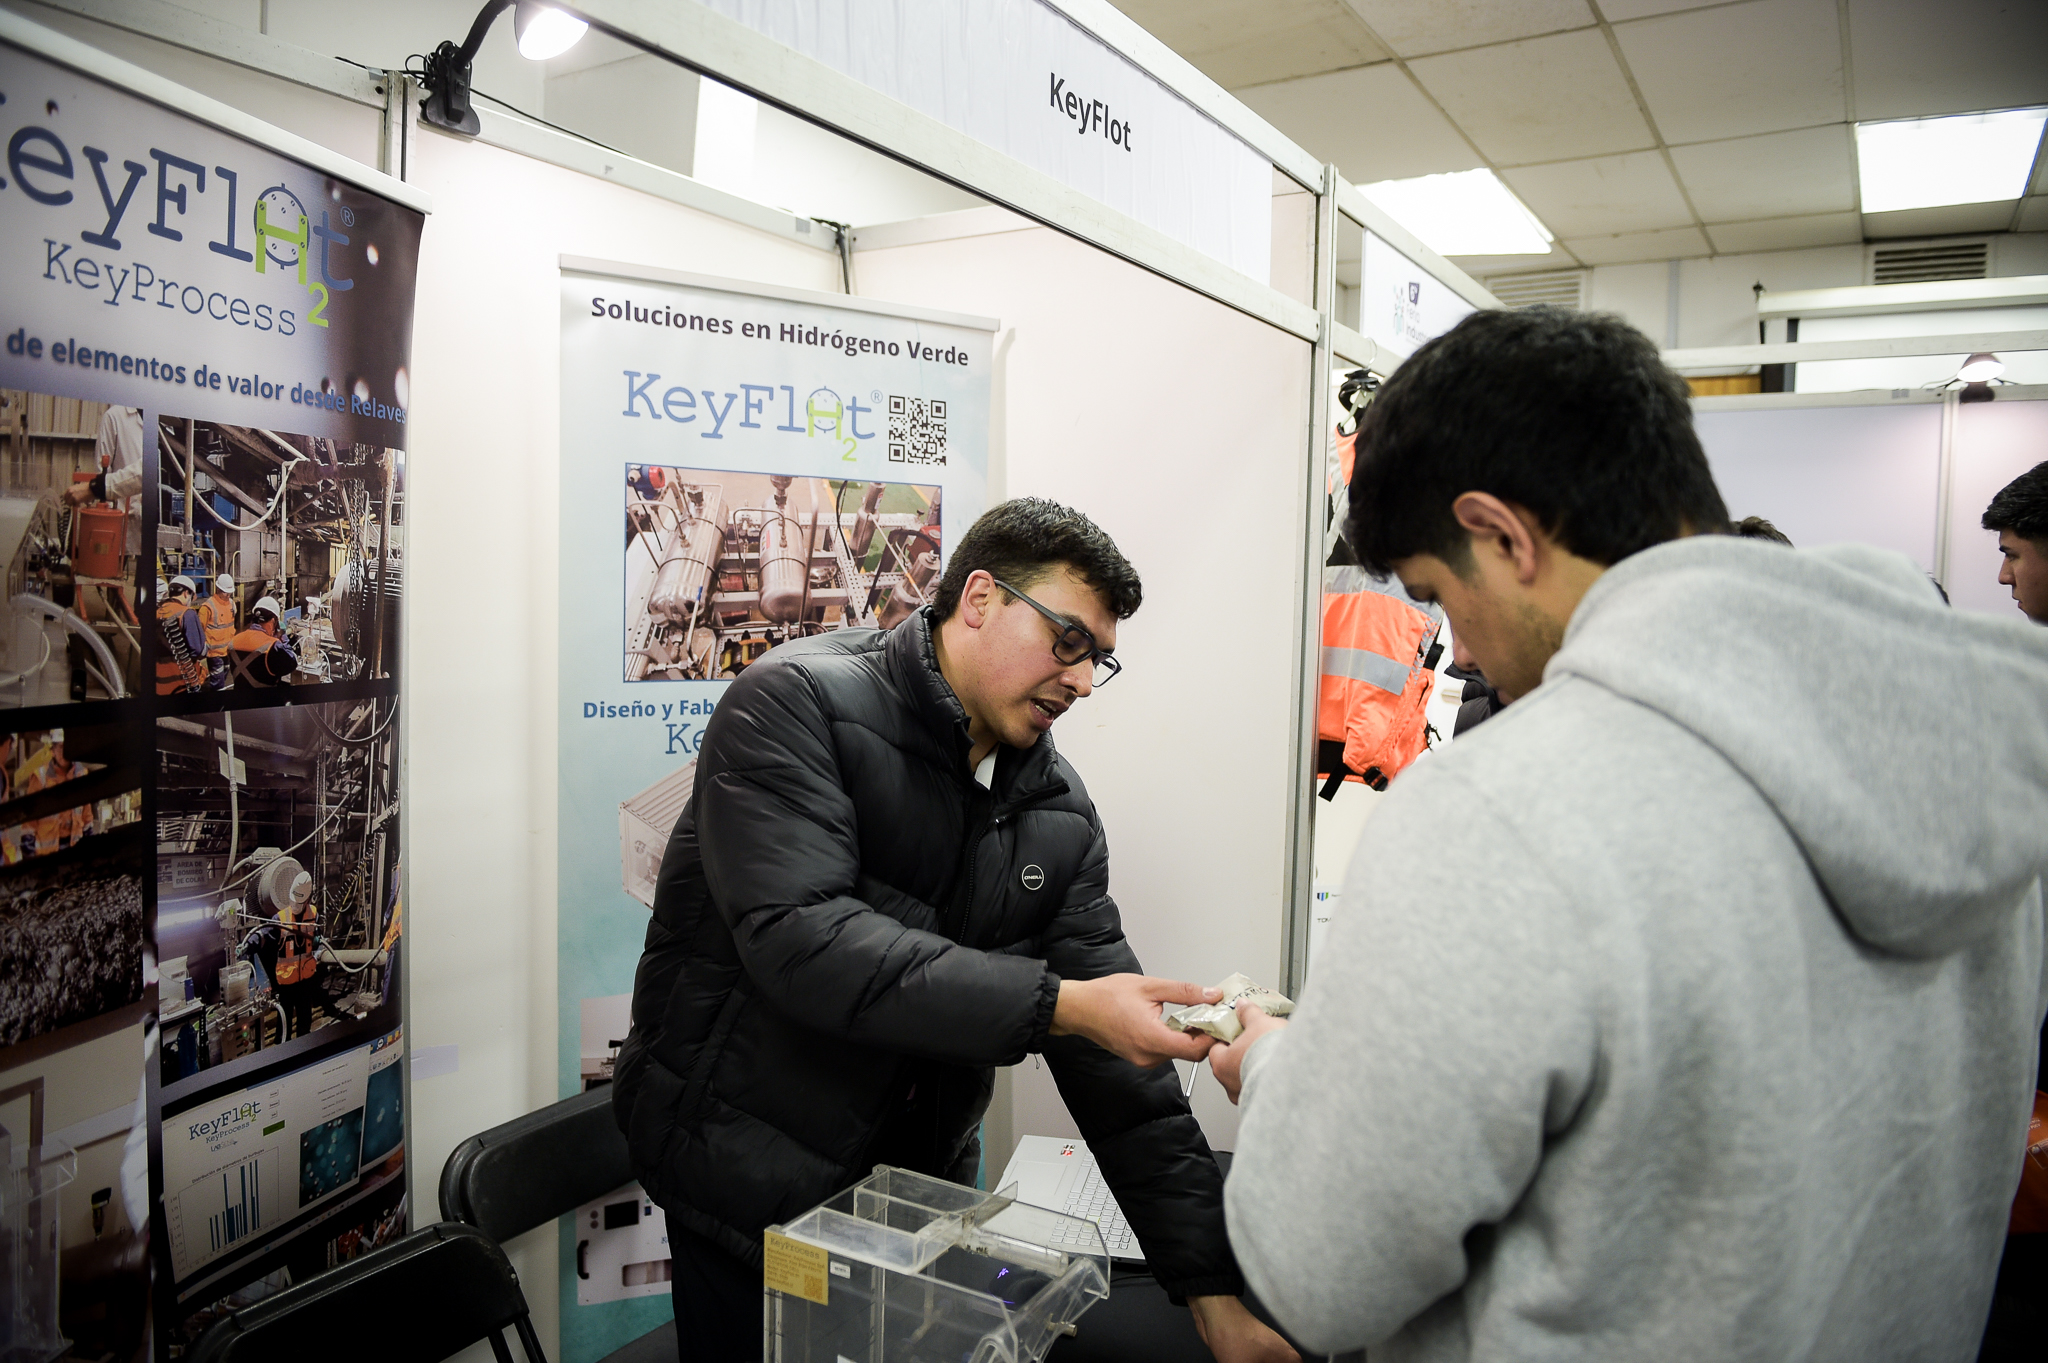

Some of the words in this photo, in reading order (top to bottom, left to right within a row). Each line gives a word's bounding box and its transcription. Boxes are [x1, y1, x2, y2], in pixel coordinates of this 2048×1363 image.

[1050, 72, 1131, 152] KeyFlot
[43, 239, 297, 336] KeyProcess
[592, 297, 733, 335] Soluciones
[742, 321, 771, 340] en
[780, 322, 900, 357] Hidrógeno
[907, 340, 969, 366] Verde
[7, 327, 43, 359] de
[52, 337, 186, 385] elementos
[194, 364, 221, 390] de
[227, 374, 284, 400] valor
[290, 382, 345, 412] desde
[351, 394, 406, 425] Relaves
[583, 700, 656, 718] Diseño
[662, 703, 673, 721] y
